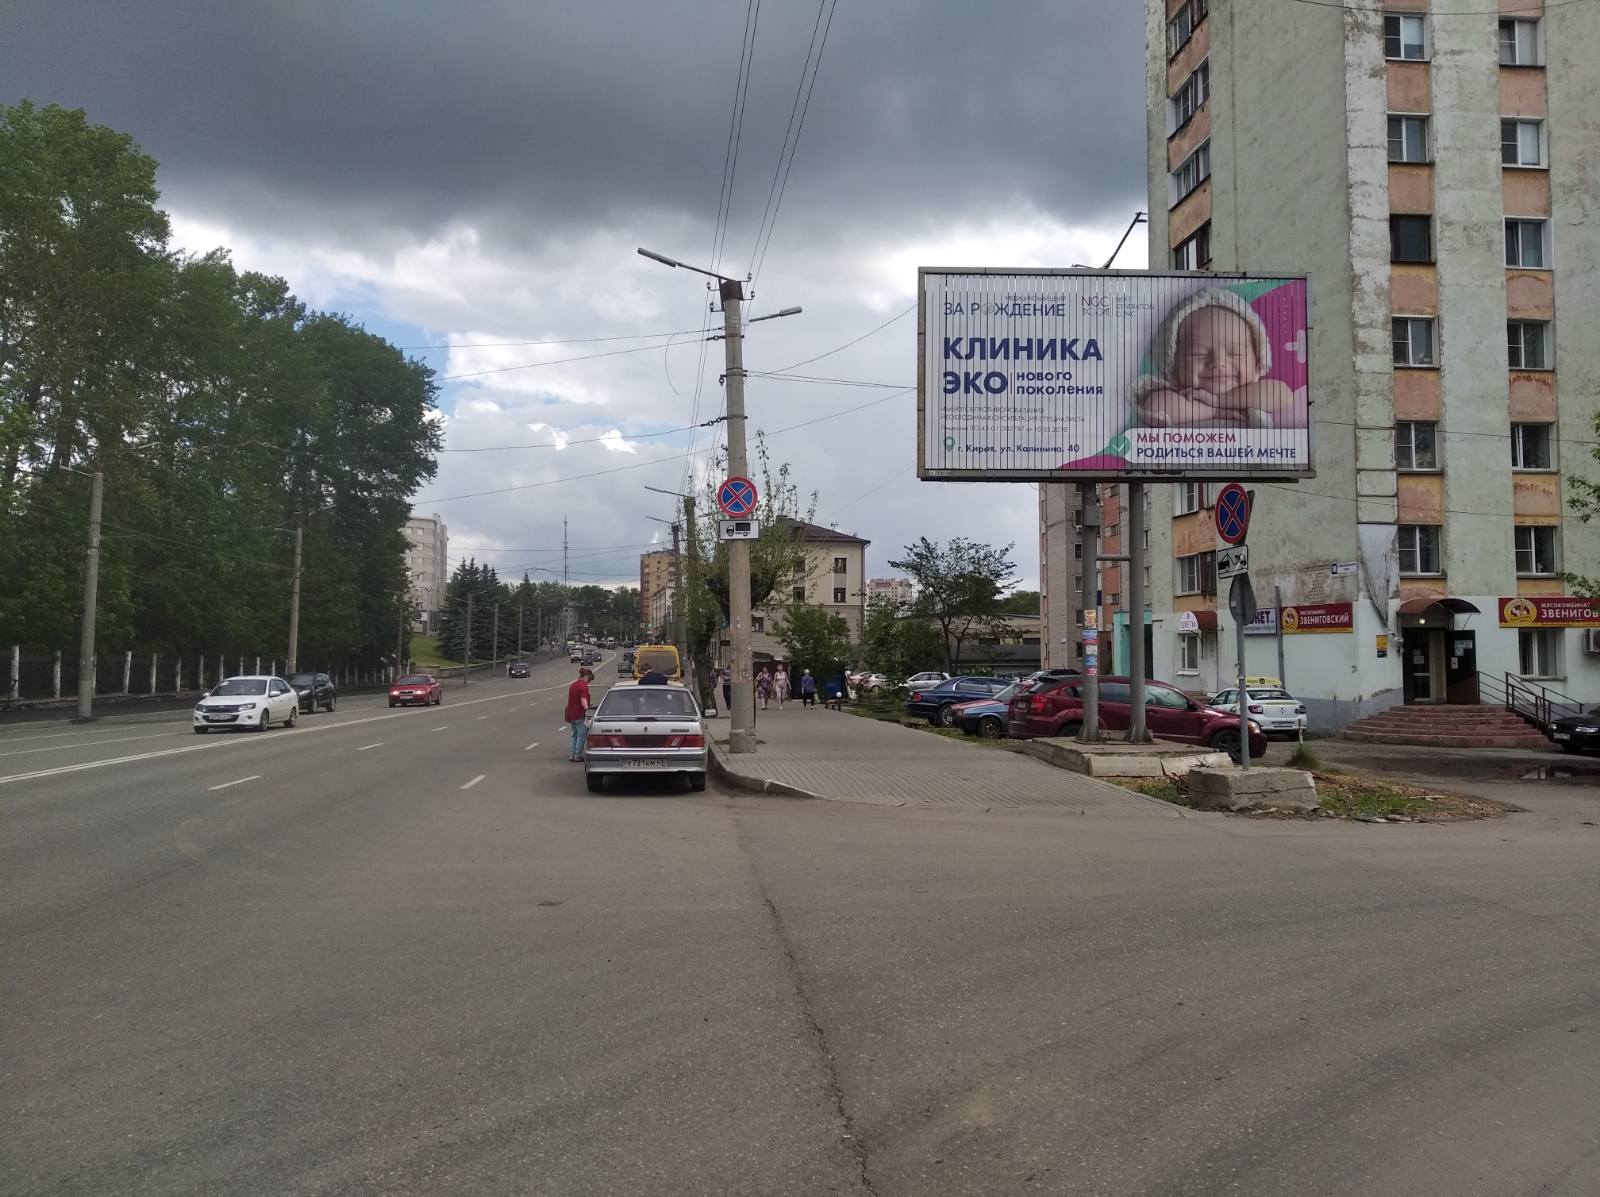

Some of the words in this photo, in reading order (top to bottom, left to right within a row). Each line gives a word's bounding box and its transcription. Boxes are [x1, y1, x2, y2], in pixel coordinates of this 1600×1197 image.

[943, 337, 1103, 361] КЛИНИКА
[943, 371, 1009, 395] ЭКО
[1017, 385, 1103, 395] поколения
[1137, 433, 1159, 443] МЫ
[1163, 433, 1236, 443] ПОМОЖЕМ
[1068, 444, 1080, 453] 40
[1137, 447, 1204, 460] РОДИТЬСЯ
[1207, 446, 1254, 459] ВАШЕЙ
[1257, 448, 1297, 459] МЕЧТЕ
[1300, 612, 1350, 625] ЗВЕНИГОВСКИЙ
